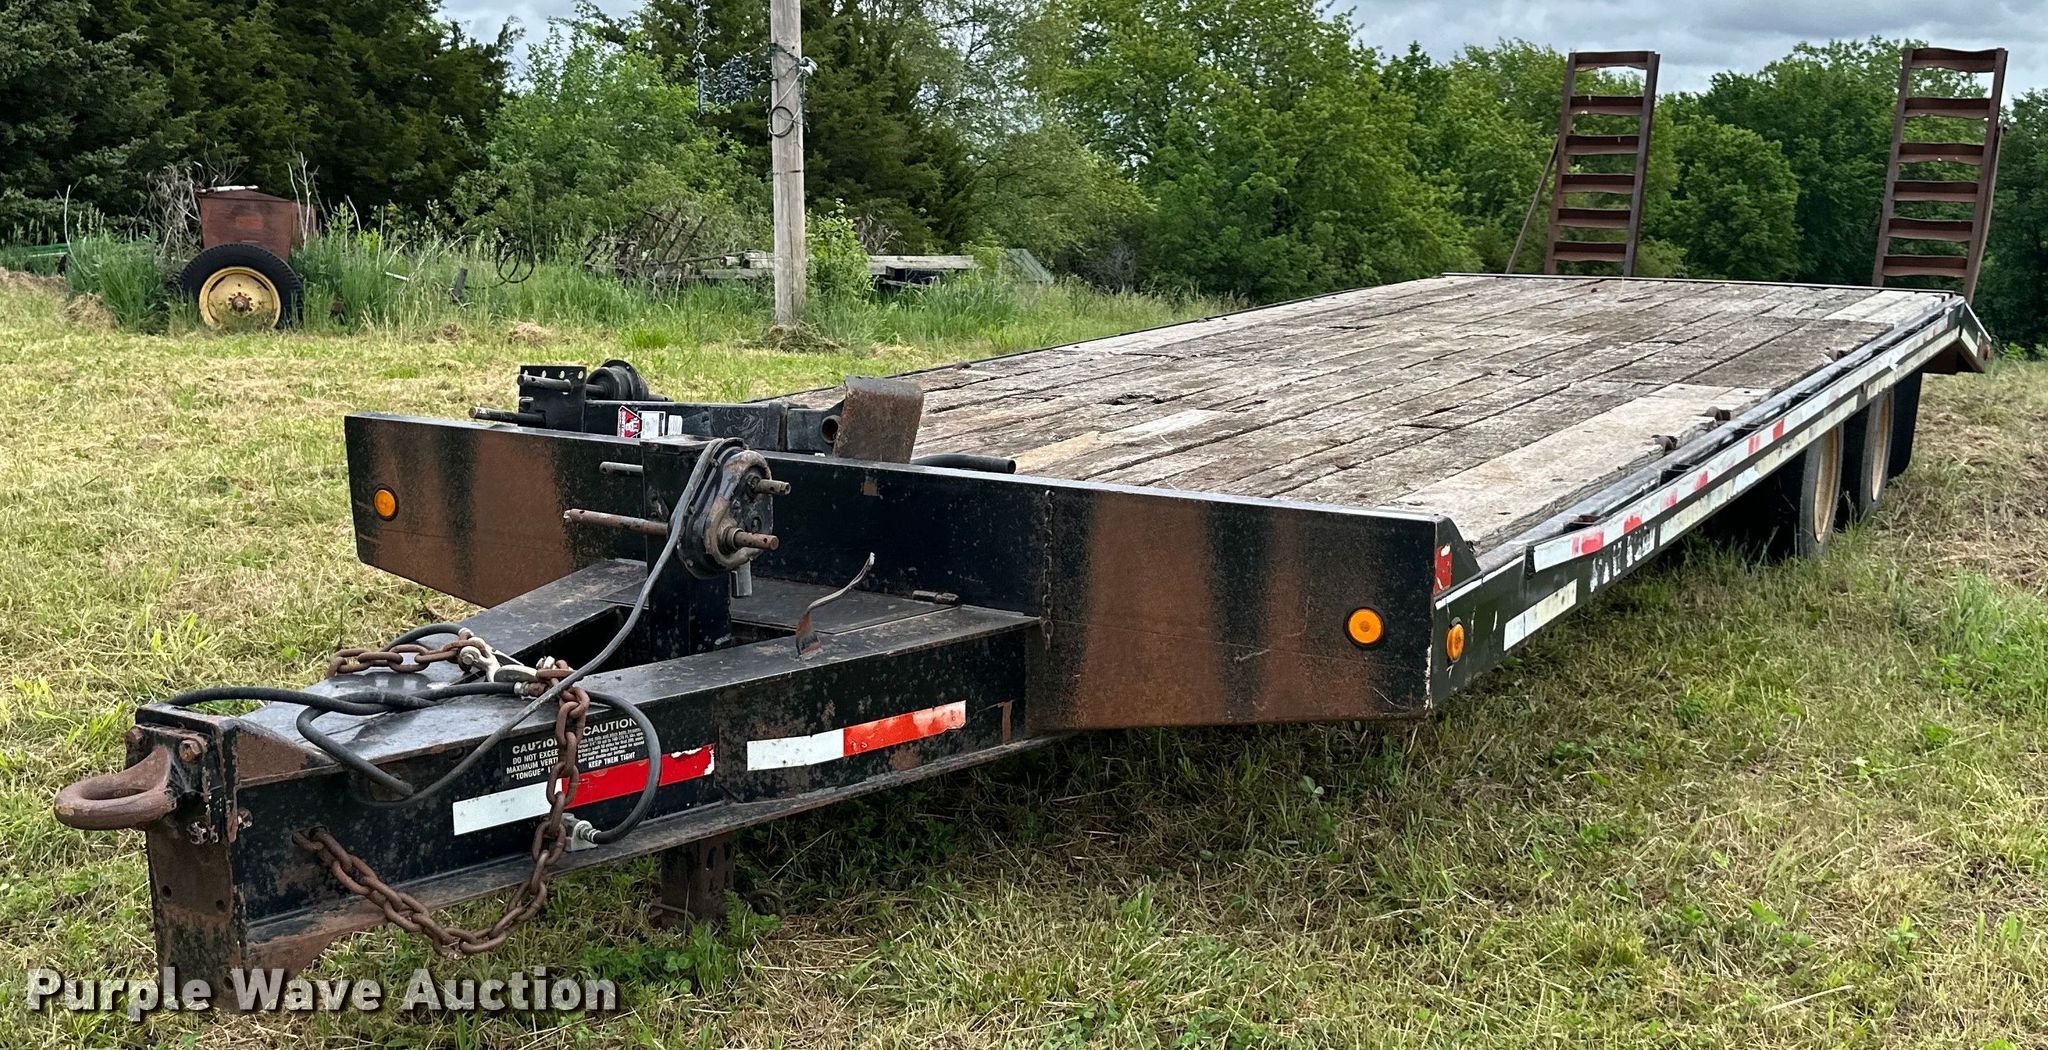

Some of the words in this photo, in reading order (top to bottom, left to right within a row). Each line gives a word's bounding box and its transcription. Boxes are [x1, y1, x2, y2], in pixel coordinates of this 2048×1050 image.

[583, 718, 637, 736] CAUTION
[512, 756, 522, 765] DO
[523, 752, 537, 763] NOT
[539, 748, 559, 759] EXCEE
[588, 759, 602, 769] KEEP
[604, 756, 619, 765] THEM
[620, 751, 636, 761] TIGHT
[506, 761, 538, 774] MAXIMUM
